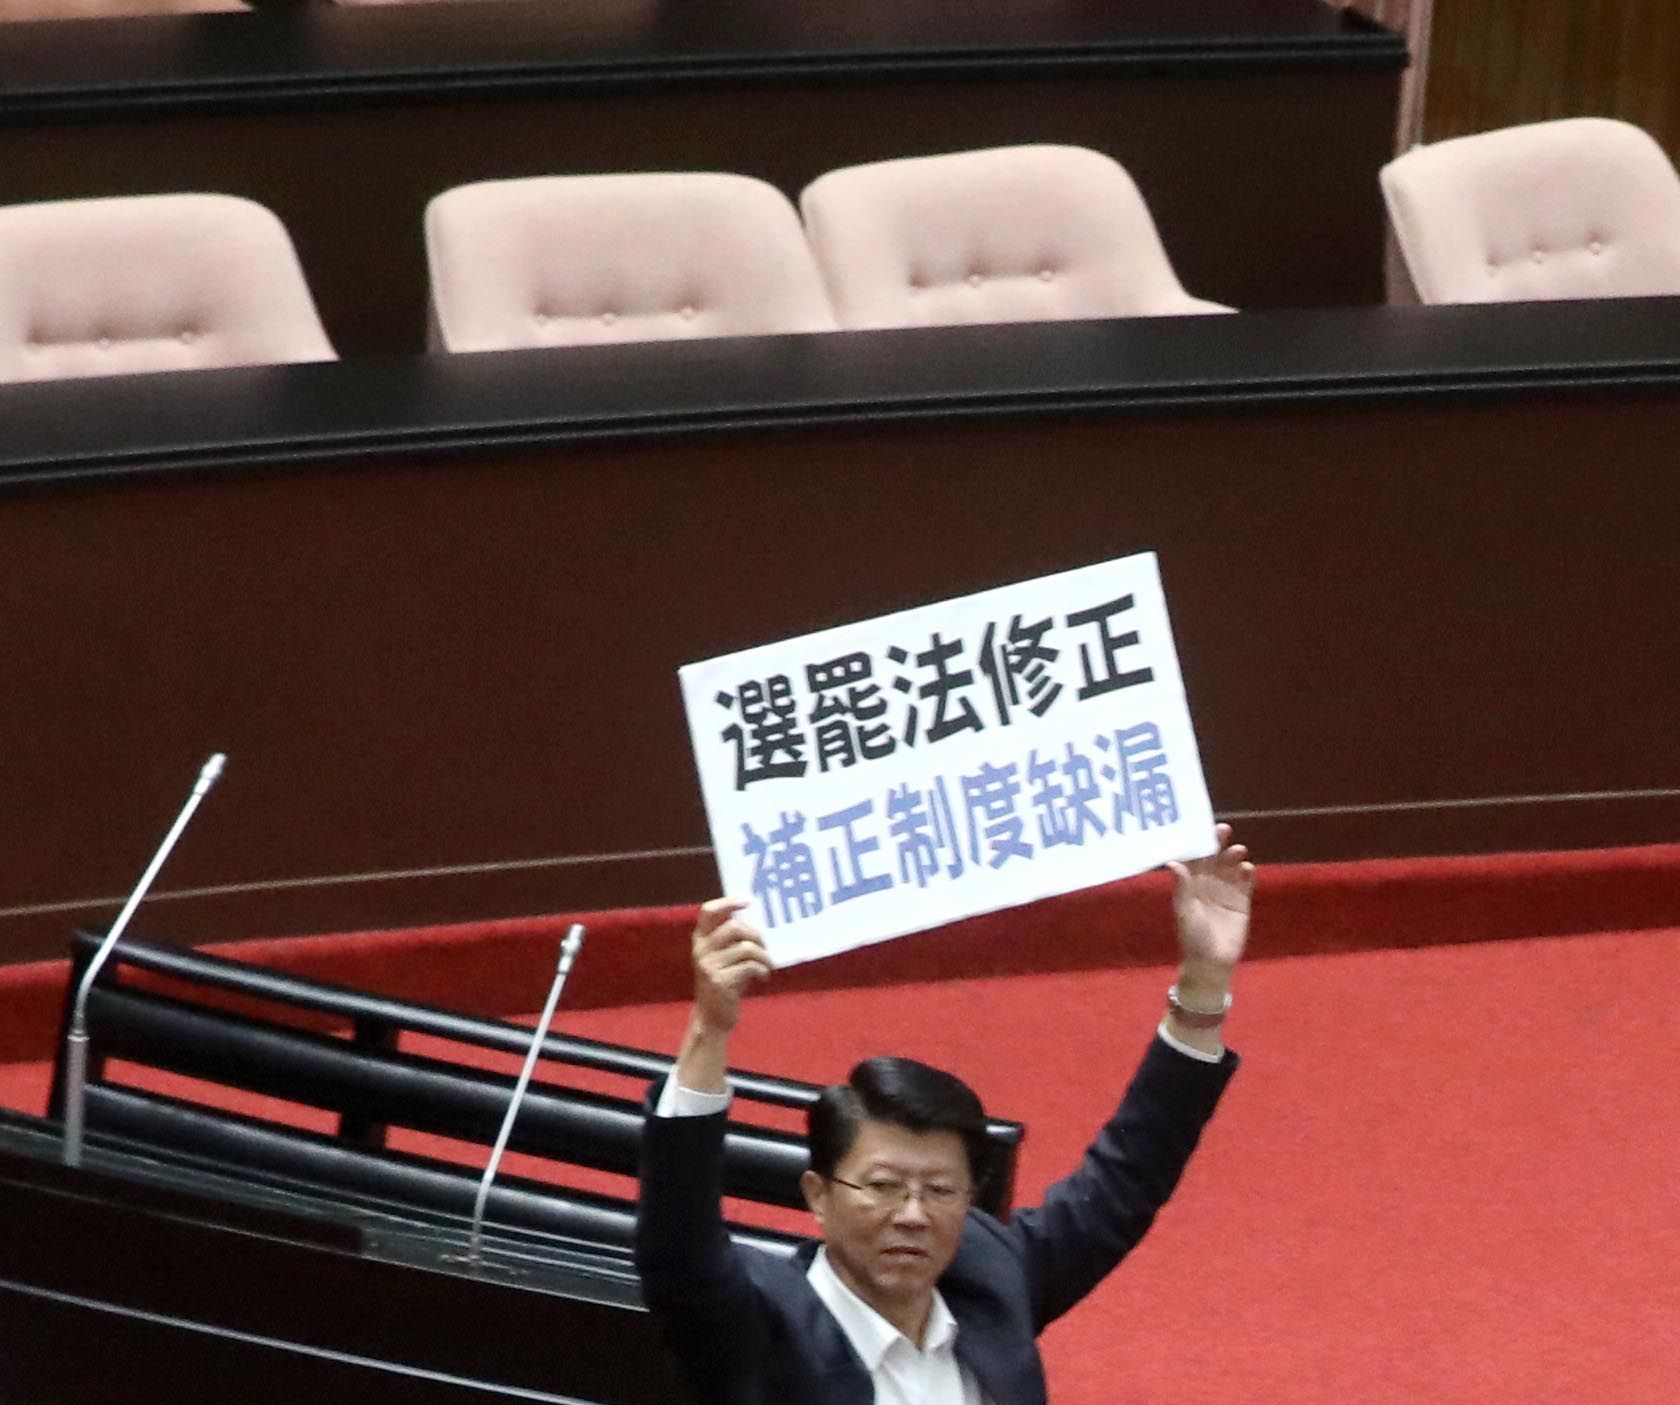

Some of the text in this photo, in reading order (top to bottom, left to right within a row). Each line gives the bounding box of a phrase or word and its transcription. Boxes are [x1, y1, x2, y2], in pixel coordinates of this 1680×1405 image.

[714, 592, 1154, 791] 選罷法修正
[740, 719, 1182, 928] 補正制度缺漏
